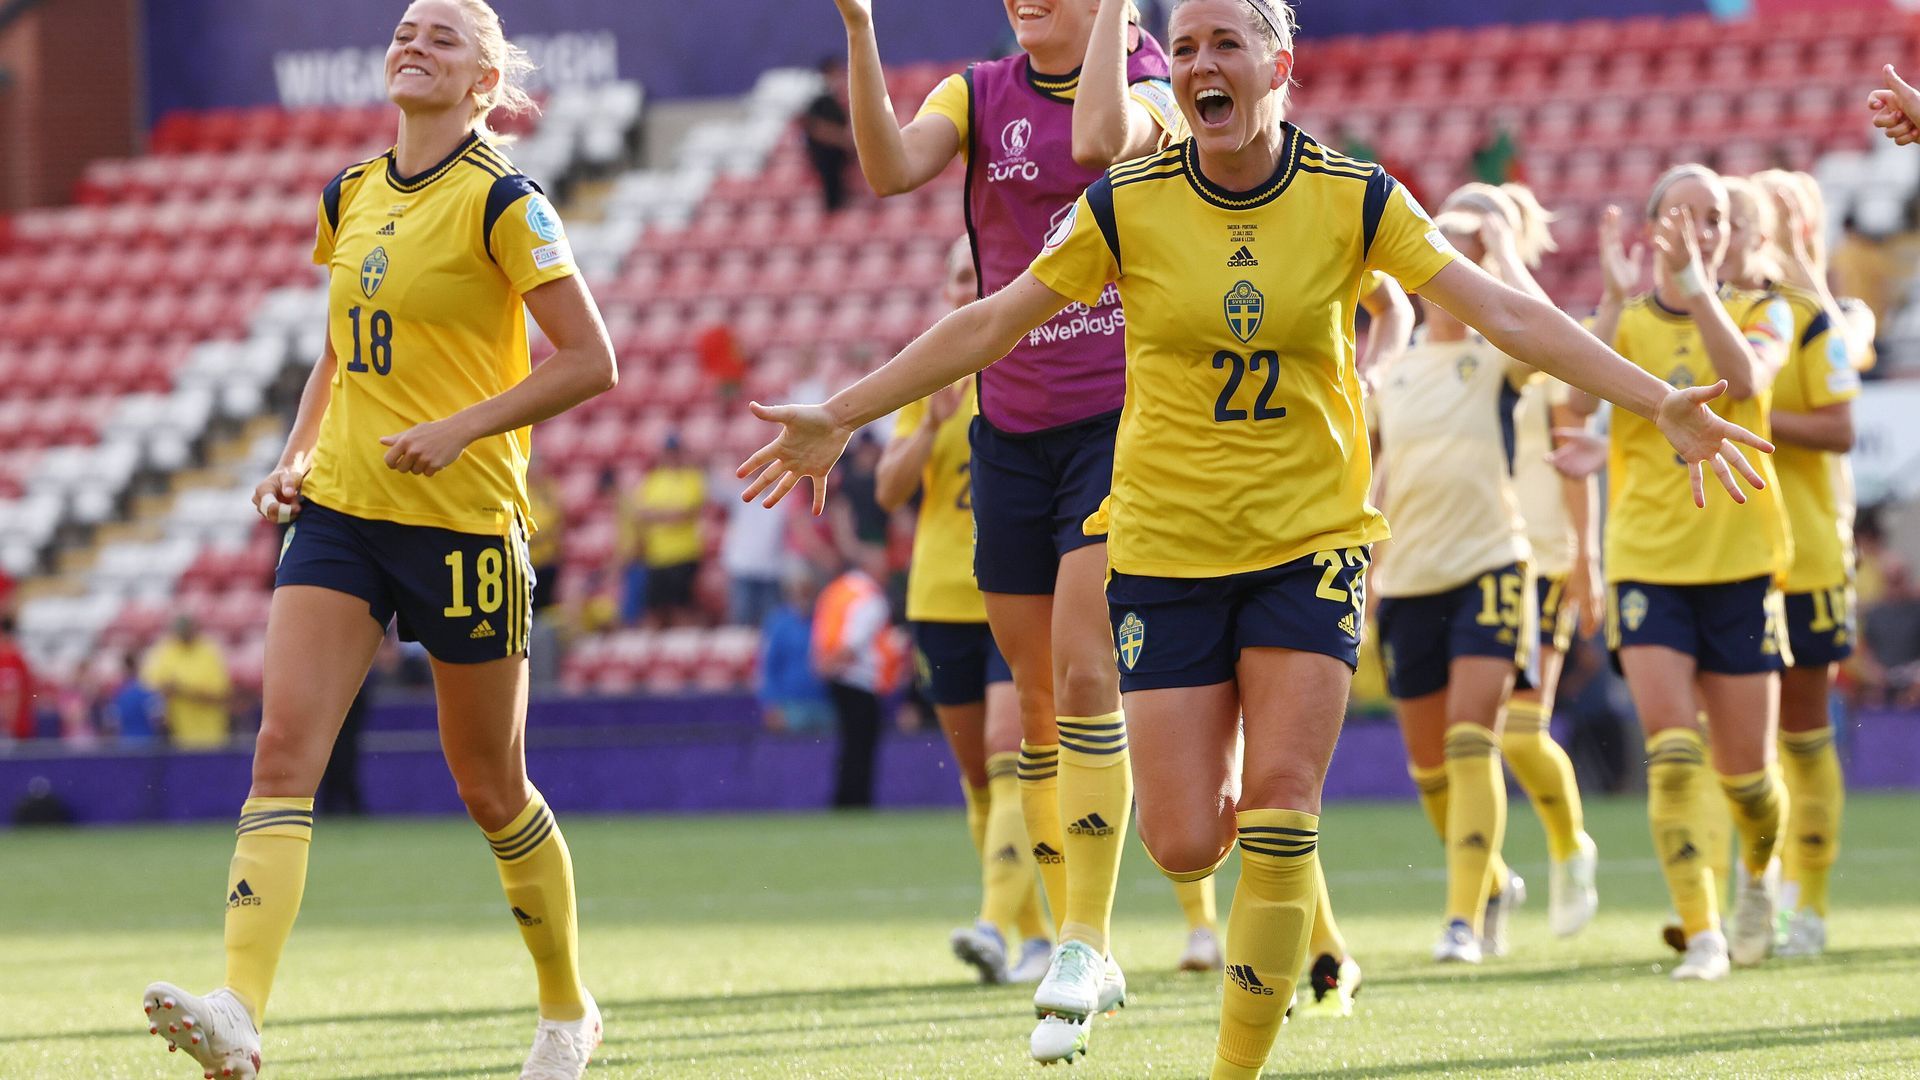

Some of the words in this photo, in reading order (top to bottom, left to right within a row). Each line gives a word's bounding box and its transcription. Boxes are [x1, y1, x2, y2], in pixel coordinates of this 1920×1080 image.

[272, 48, 388, 112] WIGA
[1226, 258, 1259, 267] adidas
[347, 305, 393, 377] 18
[1212, 349, 1287, 422] 22
[443, 547, 503, 617] 18
[1476, 573, 1522, 628] 15
[1067, 826, 1115, 837] adidas
[1226, 965, 1274, 996] adidas
